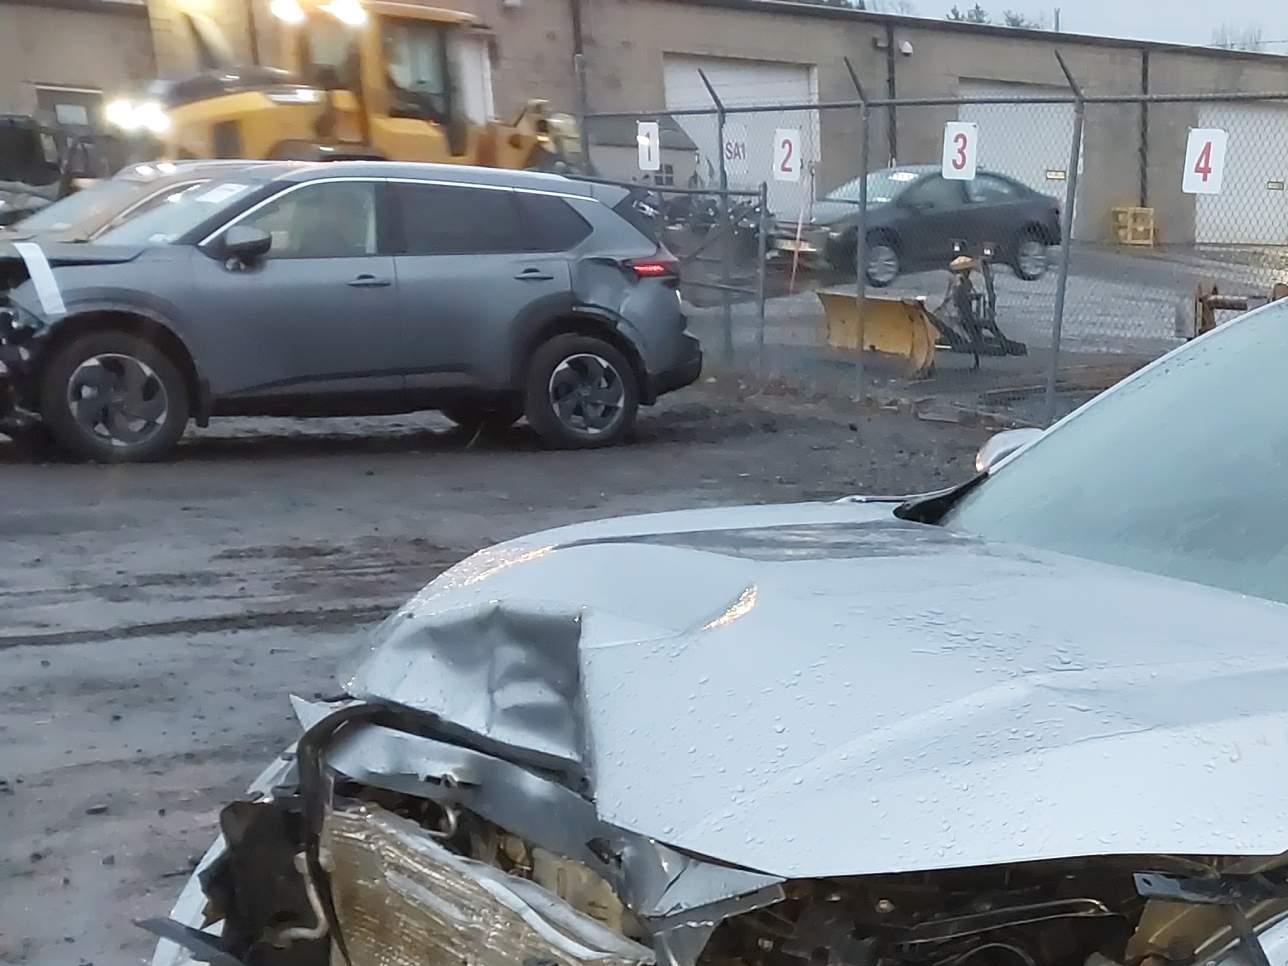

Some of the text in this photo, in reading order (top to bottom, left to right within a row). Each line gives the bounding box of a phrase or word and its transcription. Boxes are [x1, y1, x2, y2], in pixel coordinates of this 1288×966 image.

[725, 142, 746, 160] SA1
[781, 139, 792, 172] 2
[952, 133, 967, 170] 3
[1194, 141, 1211, 182] 4
